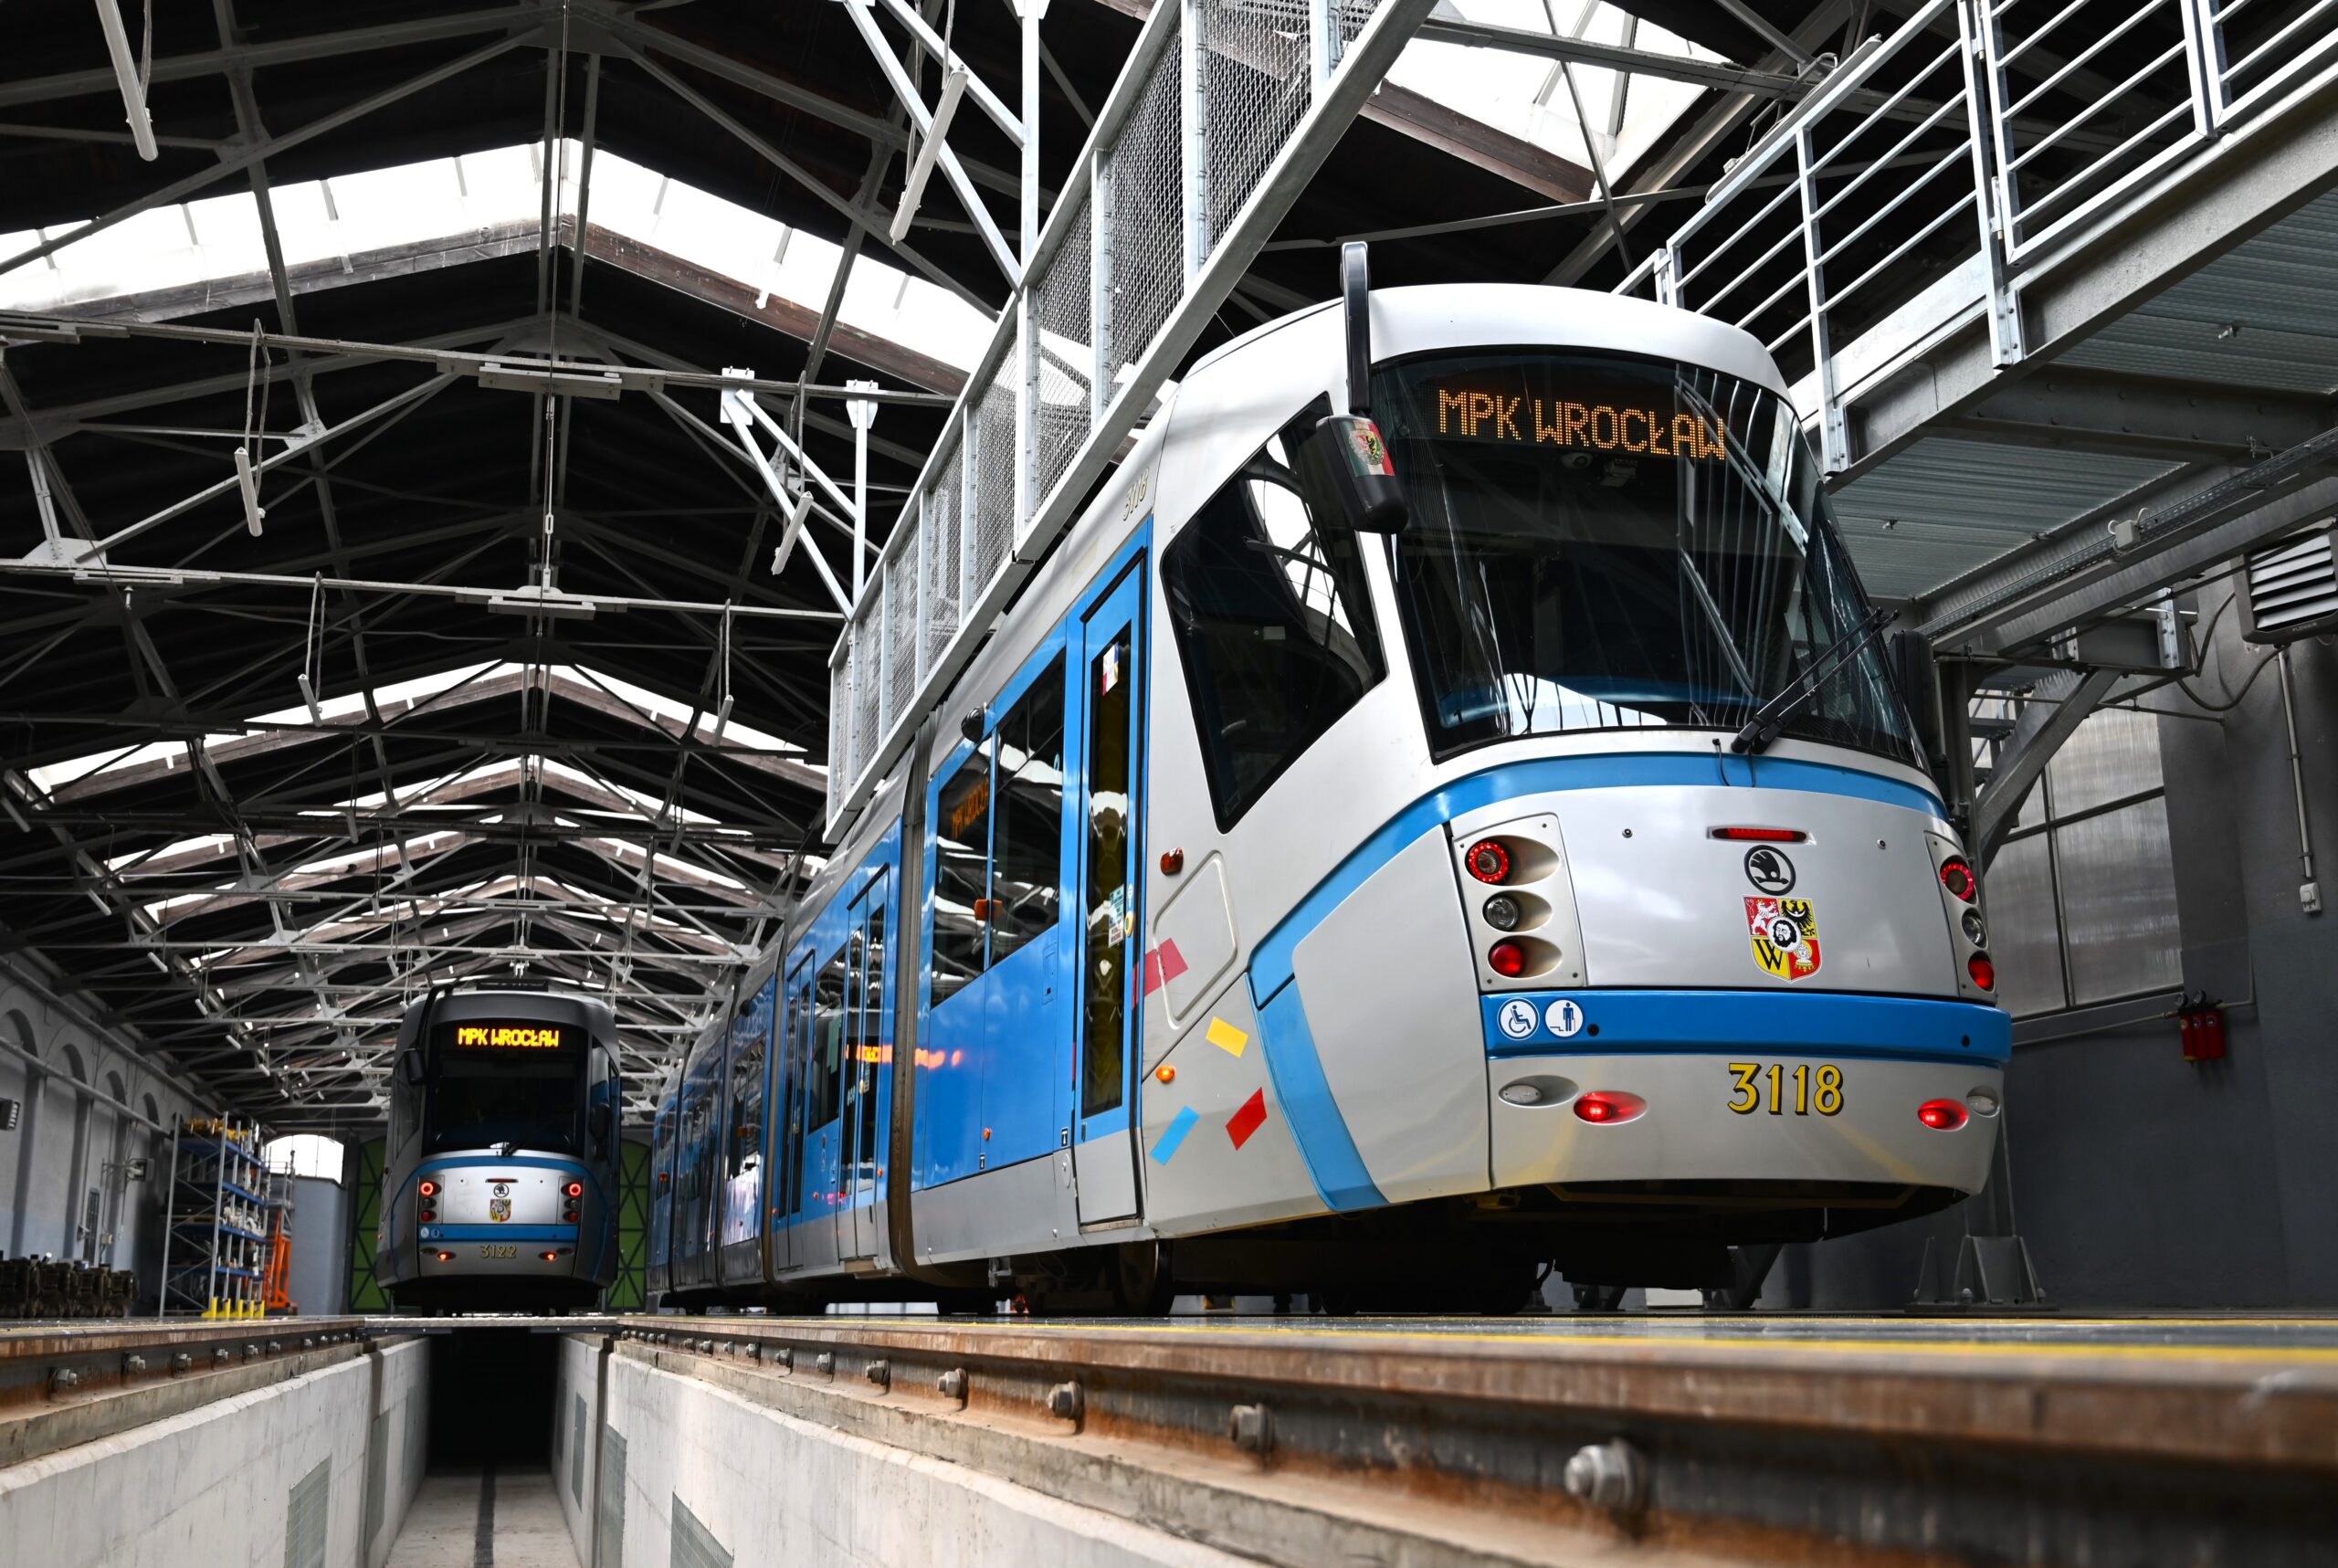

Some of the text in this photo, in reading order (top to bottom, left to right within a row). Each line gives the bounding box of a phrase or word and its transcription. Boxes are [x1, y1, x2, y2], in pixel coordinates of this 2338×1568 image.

[1438, 389, 1726, 460] MPK WROCŁAW
[1753, 939, 1784, 970] W
[458, 1027, 559, 1047] MPK WROCŁAW
[1727, 1063, 1844, 1116] 3118
[480, 1244, 517, 1258] 3122
